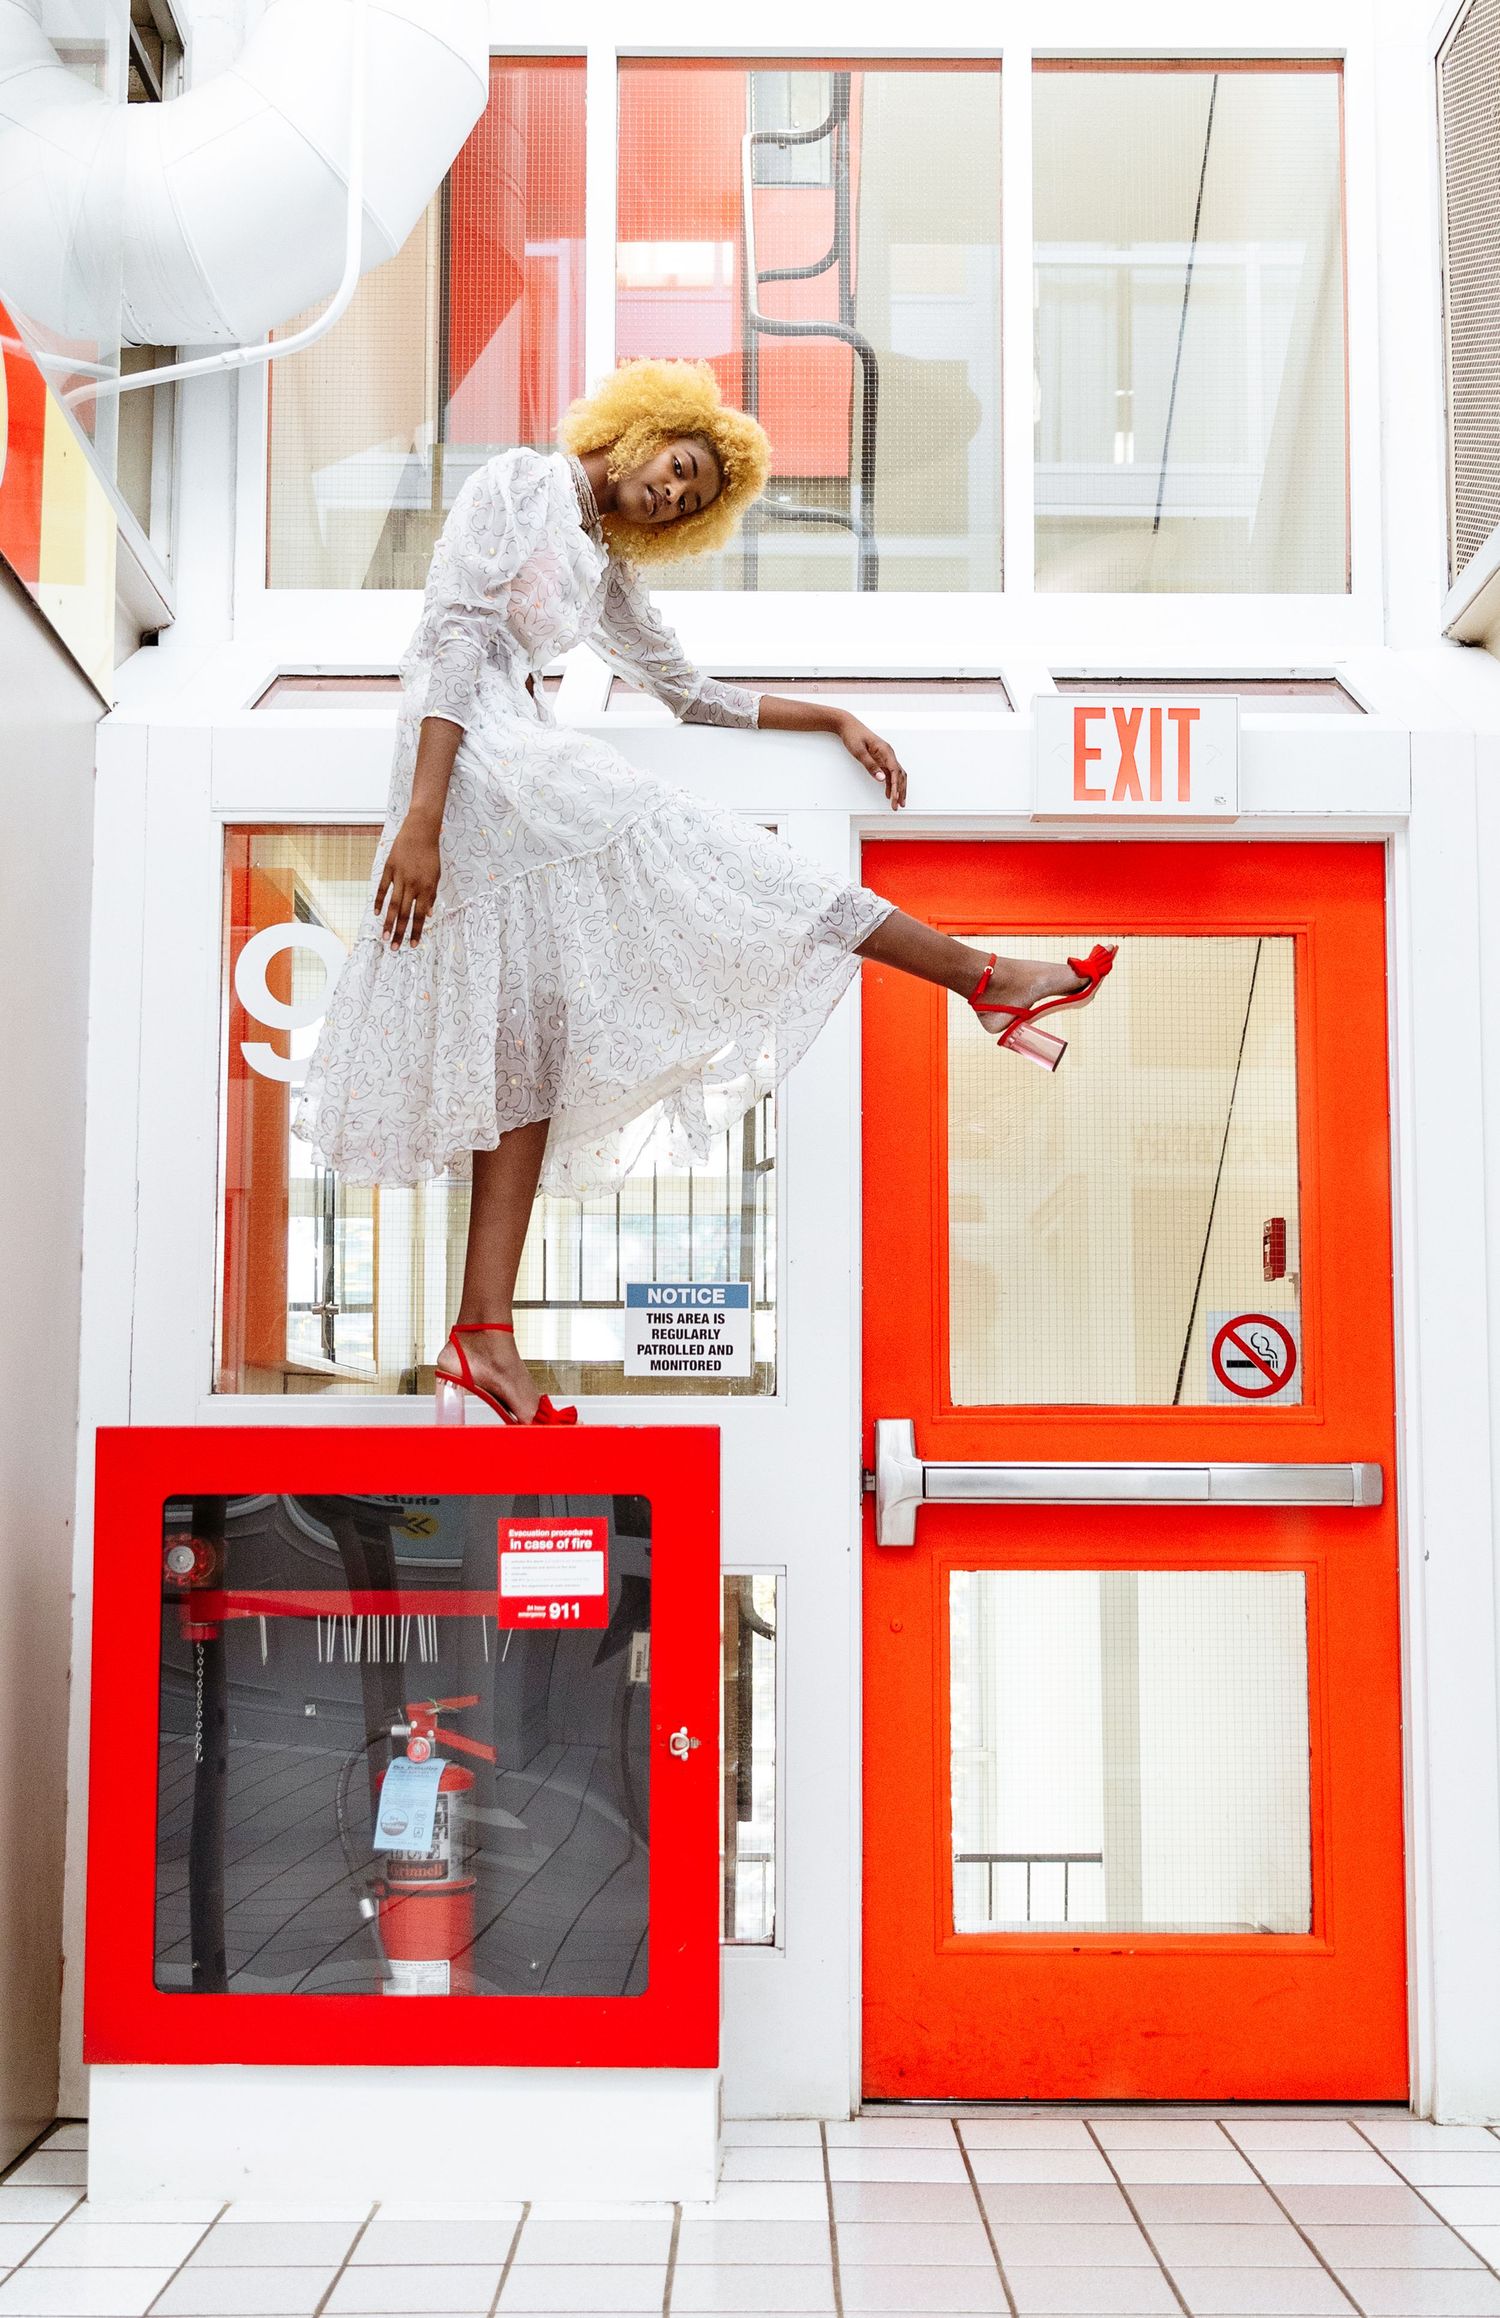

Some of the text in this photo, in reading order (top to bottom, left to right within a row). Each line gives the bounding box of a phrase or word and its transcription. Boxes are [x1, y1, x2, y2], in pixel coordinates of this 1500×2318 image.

[1073, 707, 1201, 802] EXIT
[234, 922, 348, 1082] 9
[647, 1287, 726, 1304] NOTICE
[646, 1313, 726, 1324] THIS AREA IS
[651, 1328, 721, 1340] REGULARLY
[636, 1344, 734, 1355] PATROLLED AND
[650, 1360, 722, 1371] MONITORED
[508, 1528, 594, 1538] Evacuation procedures
[509, 1537, 593, 1550] in case of fire
[549, 1602, 580, 1620] 911
